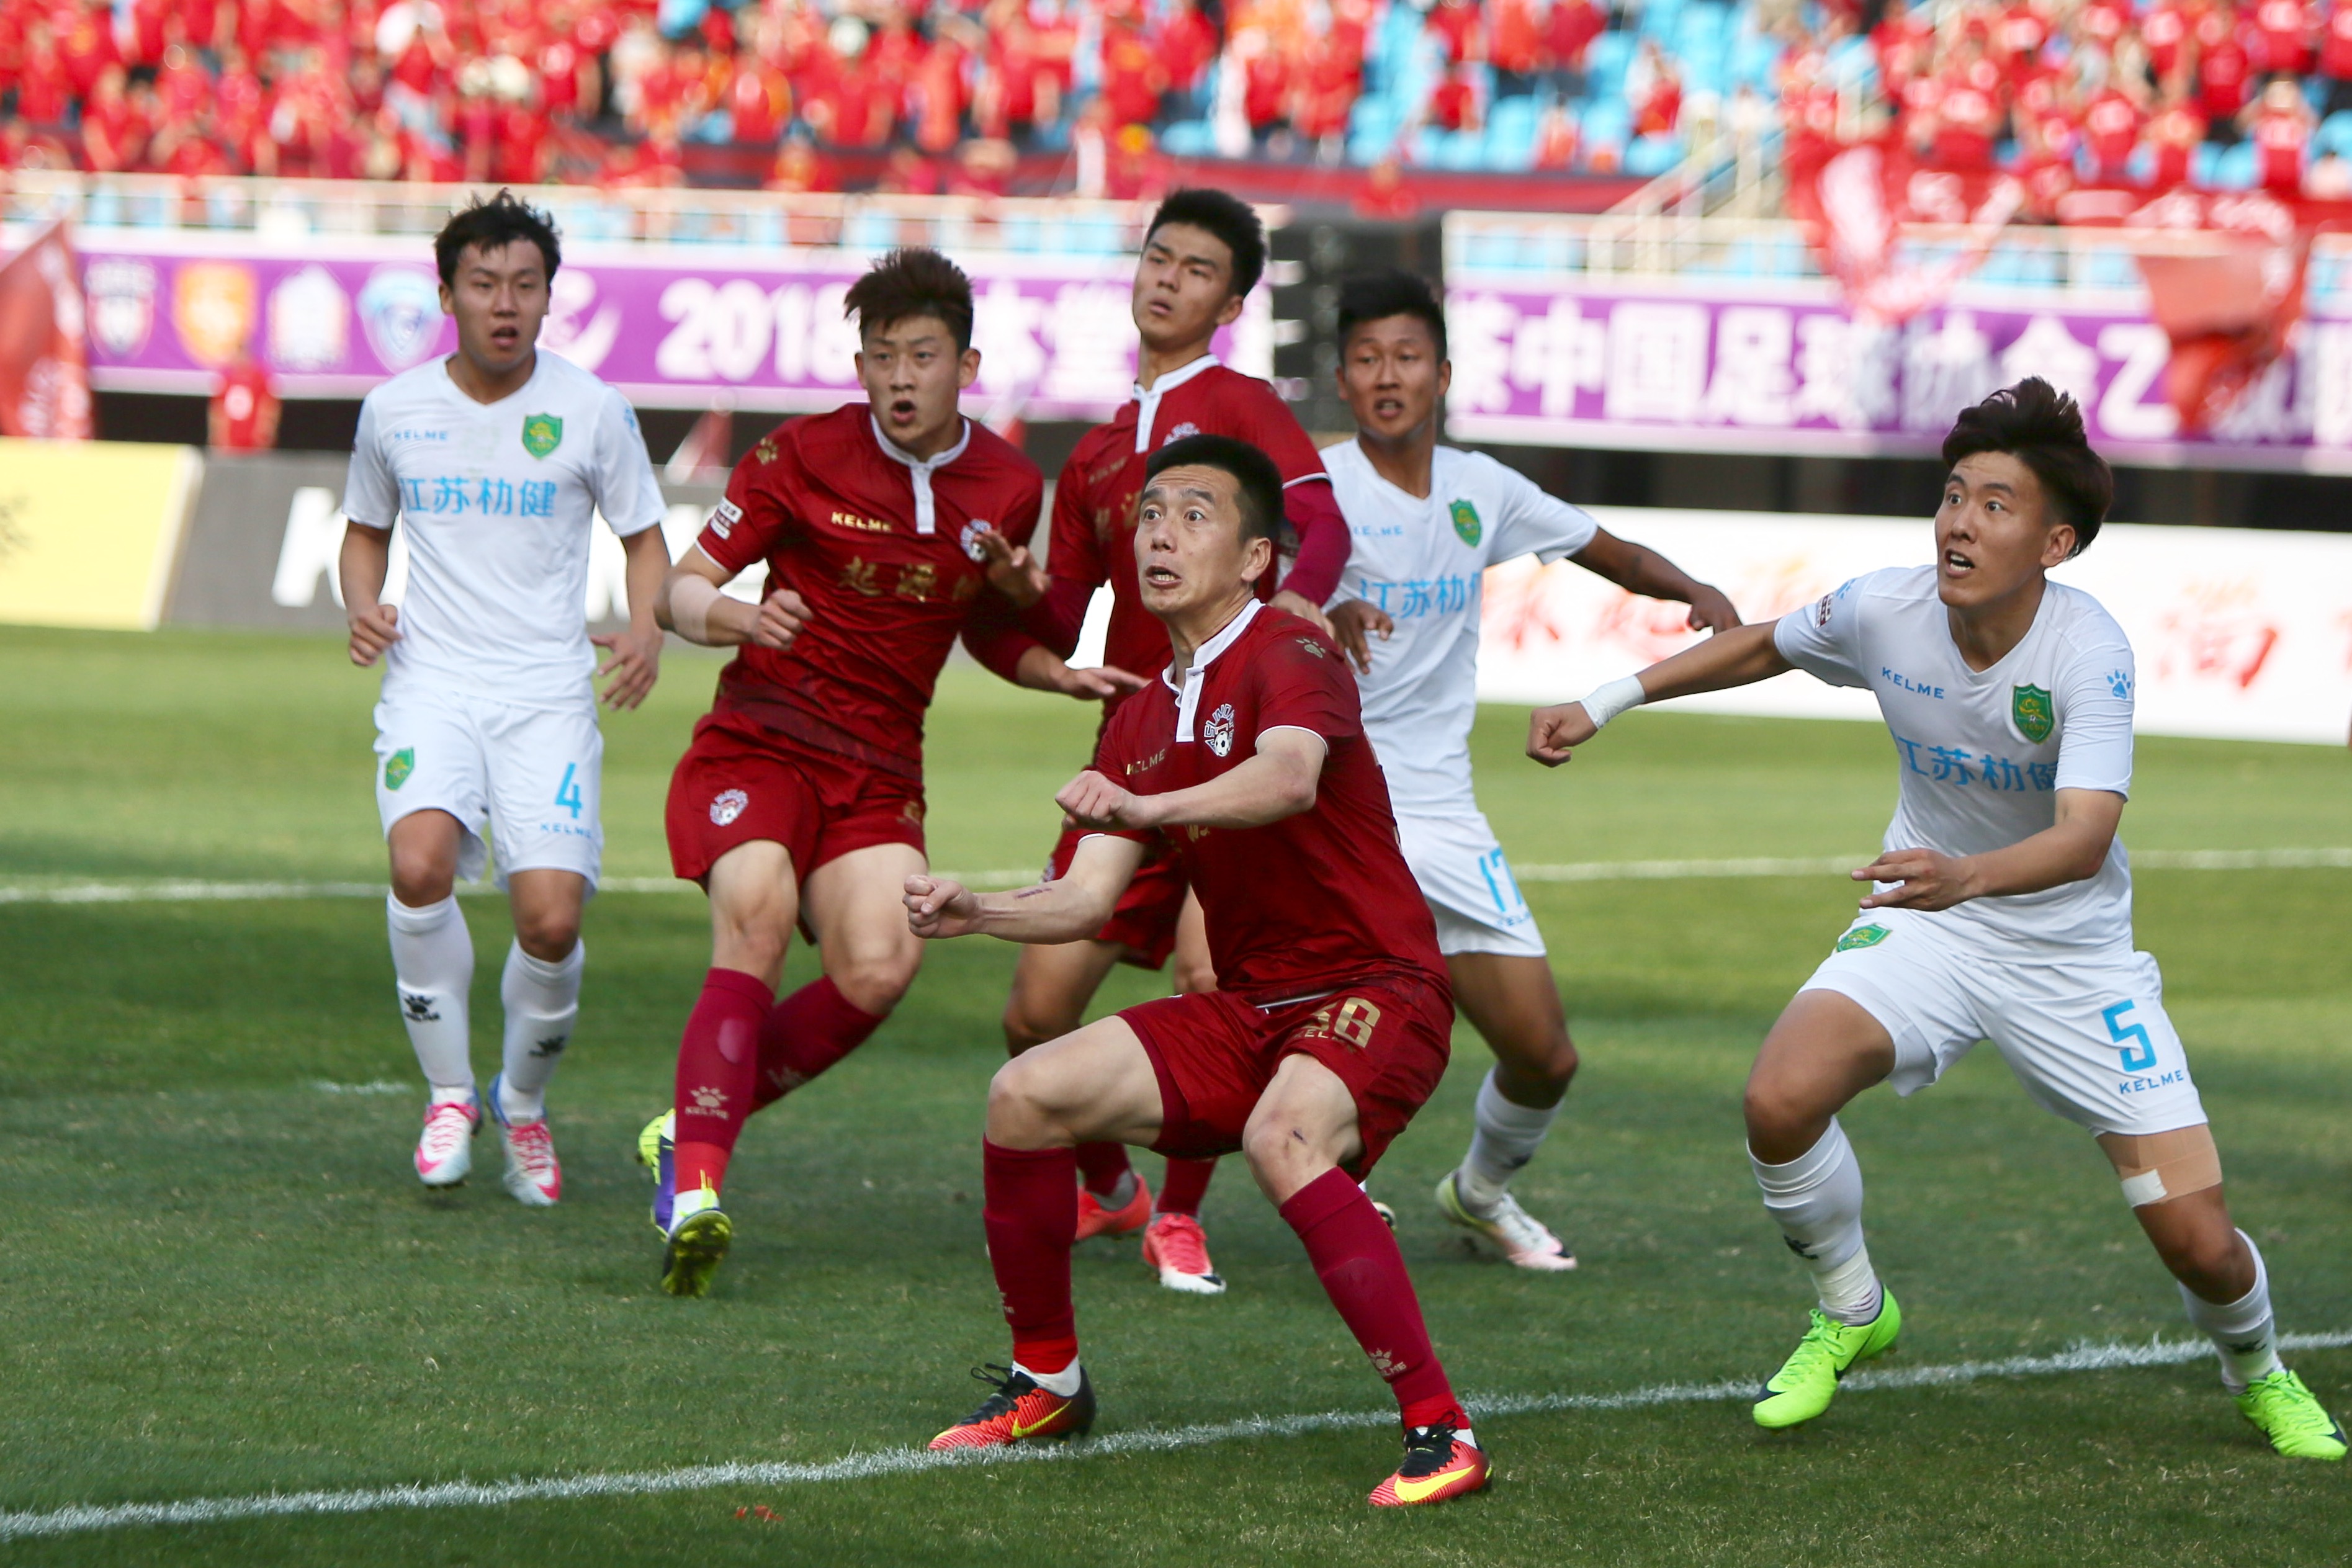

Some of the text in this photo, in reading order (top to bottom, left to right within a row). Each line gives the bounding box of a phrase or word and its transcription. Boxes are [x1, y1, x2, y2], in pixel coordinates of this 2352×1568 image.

[831, 511, 892, 532] KELME
[1882, 666, 1944, 699] KELME
[1126, 748, 1166, 775] KELME
[554, 762, 583, 819] 4
[1479, 848, 1523, 913] 17
[2101, 998, 2157, 1072] 5
[2119, 1070, 2184, 1095] KELME
